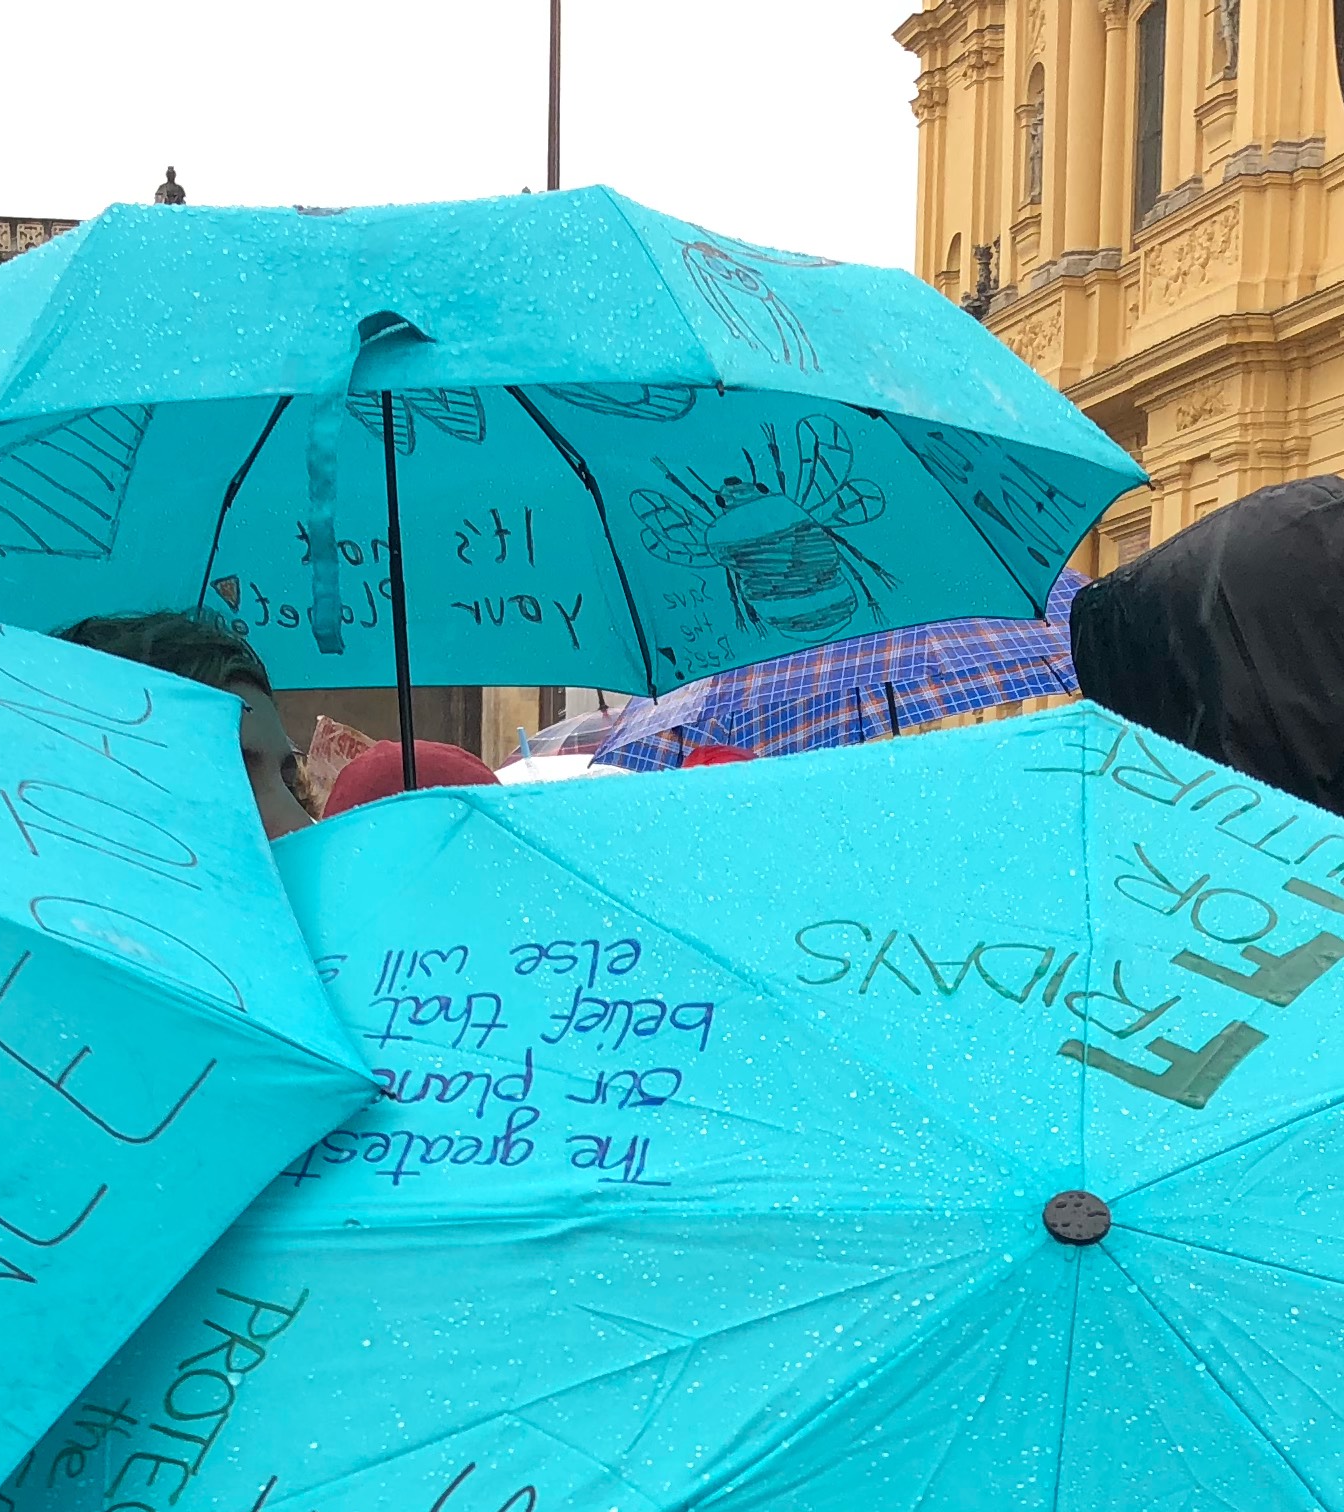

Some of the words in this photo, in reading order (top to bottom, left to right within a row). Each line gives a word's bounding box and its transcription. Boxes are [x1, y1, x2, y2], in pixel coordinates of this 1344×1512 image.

[373, 944, 469, 997] will
[509, 937, 643, 989] else
[362, 991, 508, 1050] that
[540, 985, 715, 1053] belief
[795, 918, 1270, 1110] FRIDAYS
[566, 1135, 672, 1187] The
[47, 1398, 137, 1488] the
